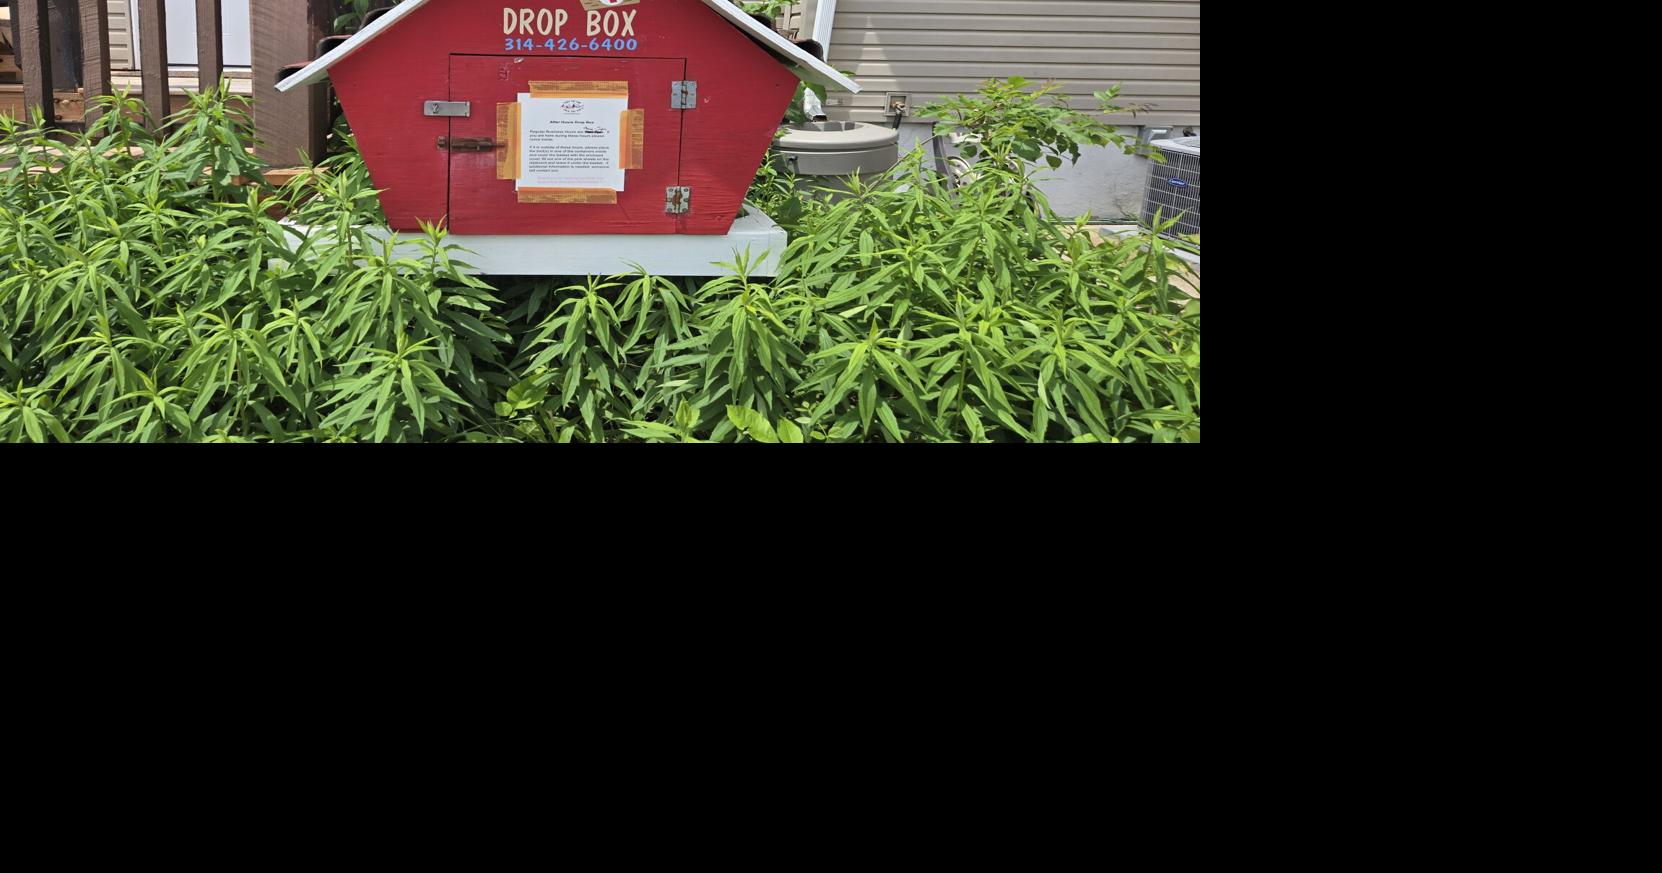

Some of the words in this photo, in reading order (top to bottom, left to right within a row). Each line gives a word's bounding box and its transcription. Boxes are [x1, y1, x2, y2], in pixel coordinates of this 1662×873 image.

[503, 7, 568, 36] DROP
[586, 8, 637, 37] BOX
[504, 37, 638, 51] 314-426-6400
